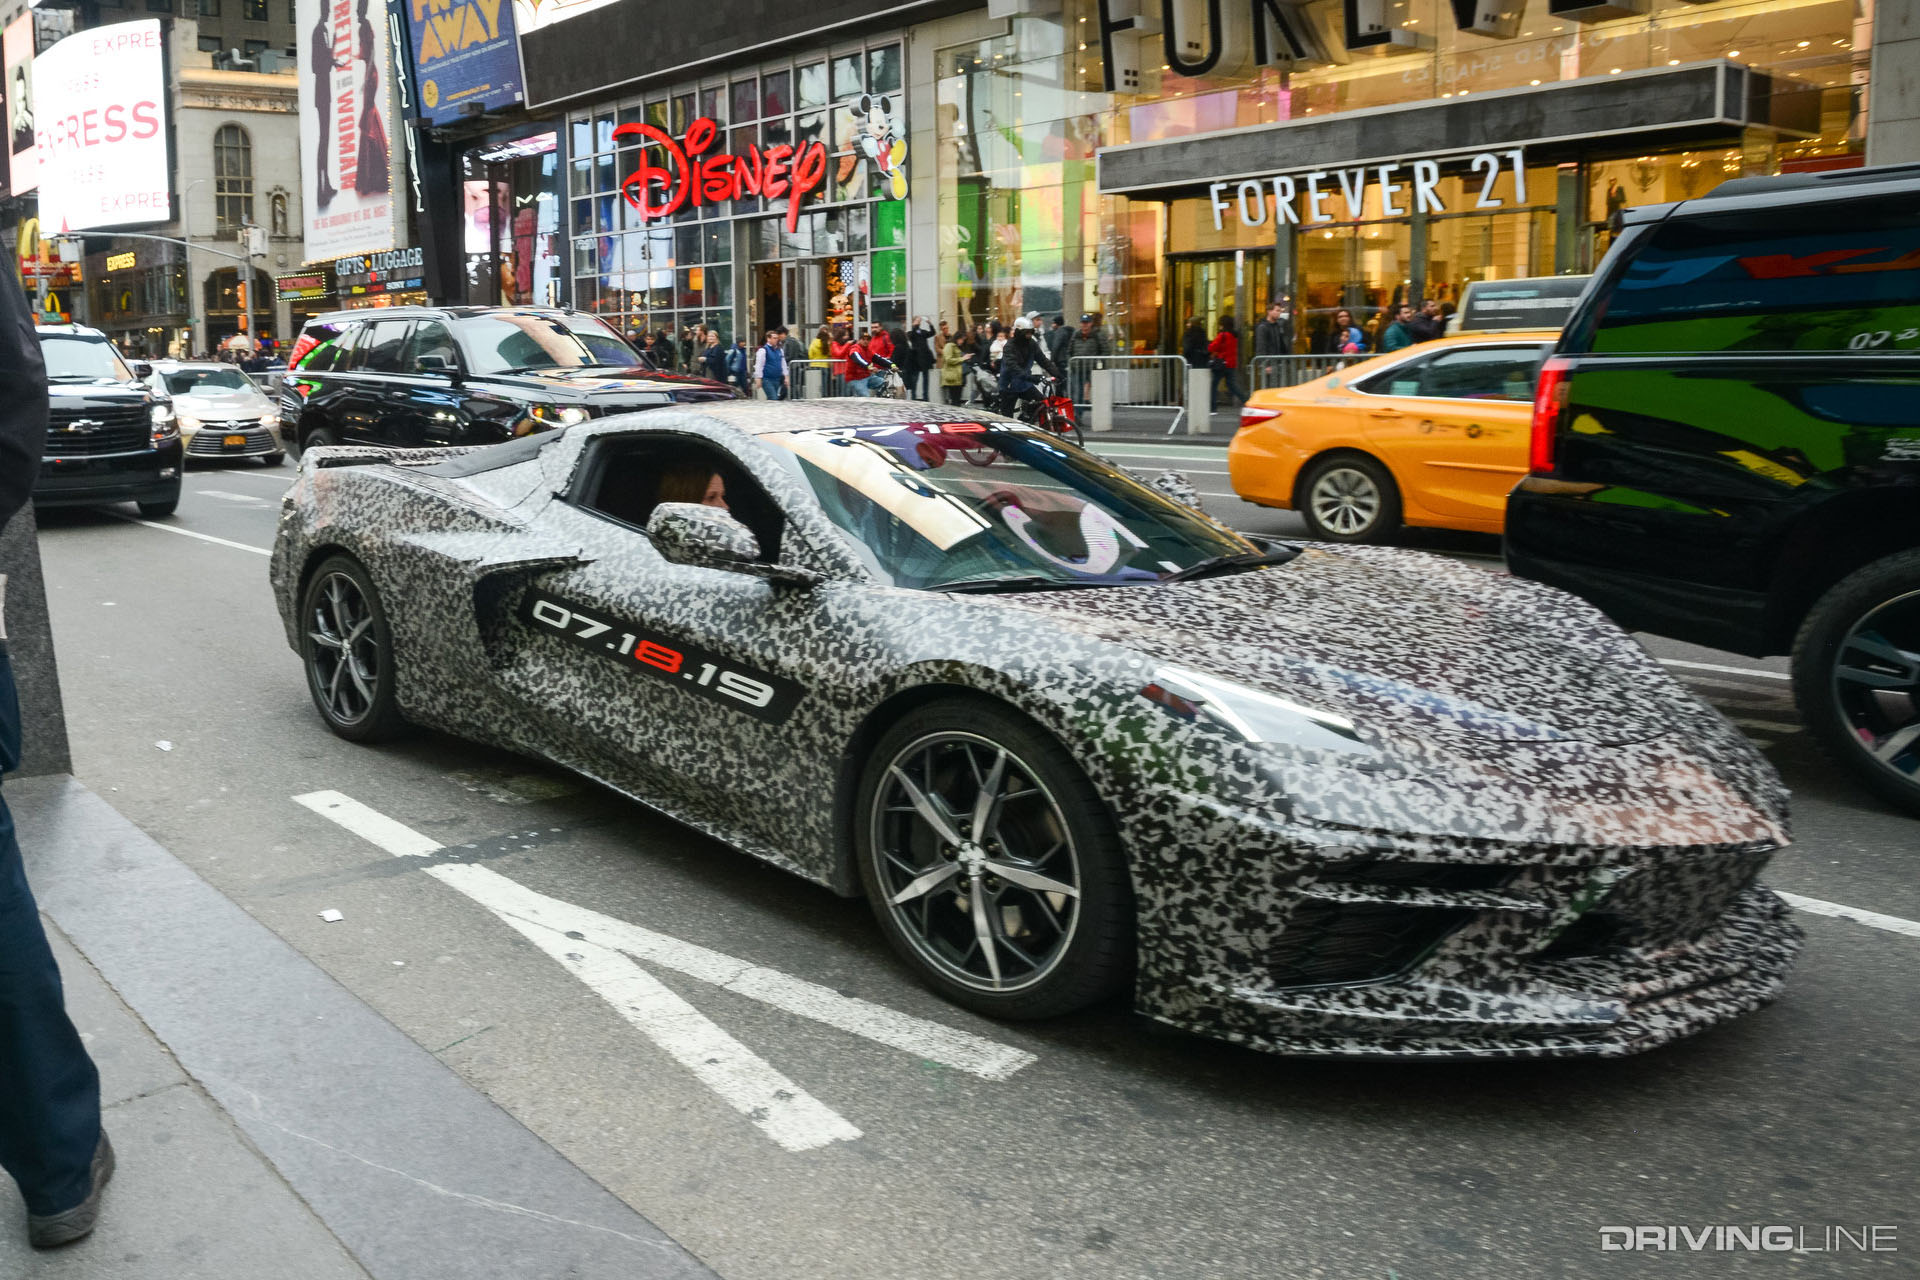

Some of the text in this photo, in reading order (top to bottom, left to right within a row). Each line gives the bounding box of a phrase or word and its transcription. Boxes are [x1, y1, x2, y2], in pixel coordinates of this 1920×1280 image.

[94, 31, 162, 56] EXPRE
[419, 0, 500, 65] AWAY
[337, 90, 358, 190] WOMAN
[101, 191, 170, 213] EXPRE
[1210, 149, 1526, 231] FOREVER 21
[107, 252, 136, 272] EXPRESS
[336, 247, 424, 276] GIFTS LUGGAGE
[386, 280, 405, 290] SONY
[532, 600, 775, 708] 07.18.19
